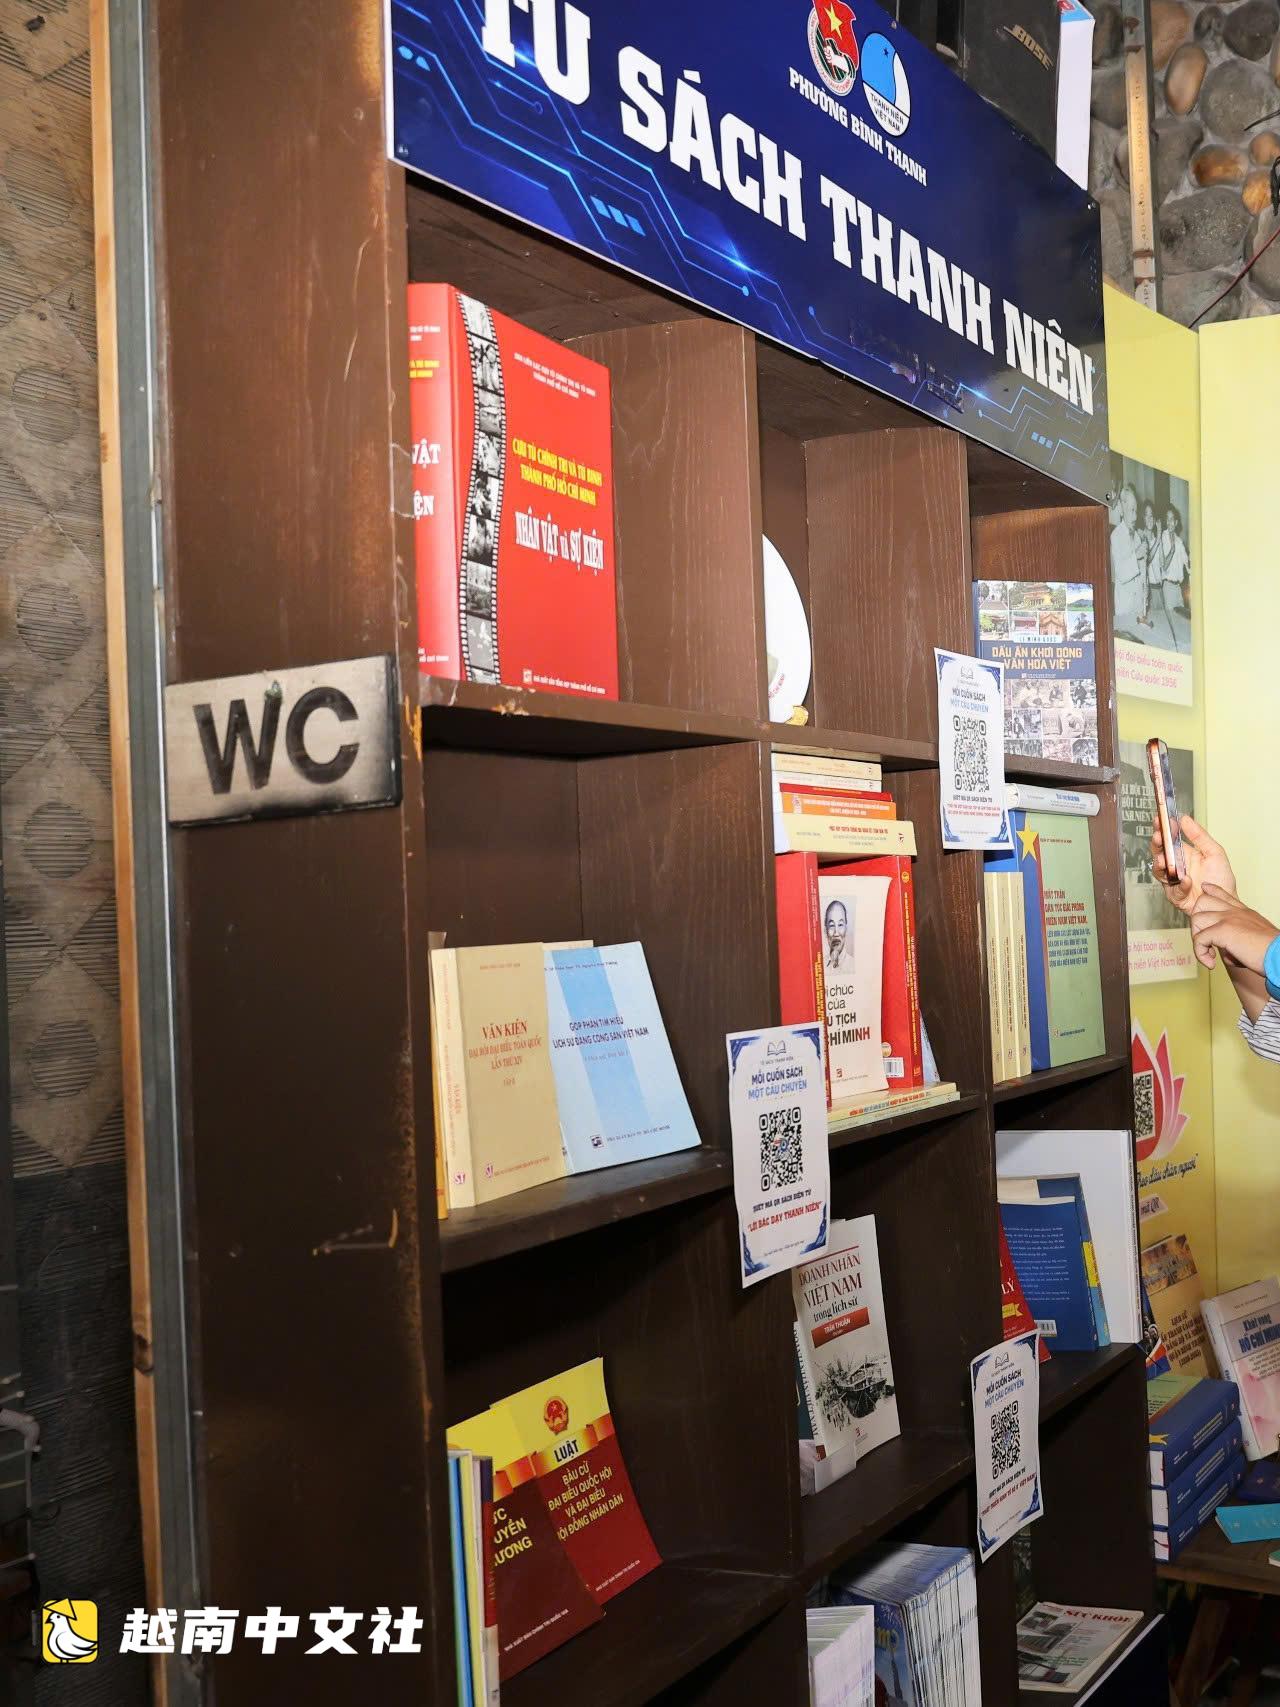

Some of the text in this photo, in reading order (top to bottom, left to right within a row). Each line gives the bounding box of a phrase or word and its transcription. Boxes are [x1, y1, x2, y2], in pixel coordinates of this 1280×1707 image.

[1003, 24, 1053, 70] BOSE
[789, 67, 927, 187] PHƯỜNG BÌNH THẠNH
[618, 46, 806, 241] SÁCH
[820, 176, 995, 354] THANH
[1004, 299, 1095, 414] NIÊN
[515, 506, 540, 551] NHÂN
[540, 512, 559, 563] VẬT
[570, 528, 582, 571] SỰ
[583, 529, 604, 576] KIỆN
[1050, 658, 1072, 672] VIỆT
[192, 687, 360, 795] WC
[829, 984, 854, 997] chúc
[827, 998, 846, 1011] của
[482, 1022, 503, 1040] VĂN
[635, 1026, 650, 1038] NAM
[835, 1012, 857, 1028] TỊCH
[842, 1026, 870, 1044] MINH
[751, 1065, 803, 1085] MỖI CUỐN SÁCH
[765, 1082, 780, 1096] CÂU
[781, 1078, 807, 1093] CHUYỆN
[784, 1206, 804, 1220] THANH
[798, 1253, 861, 1286] DOANH NHÂN
[803, 1272, 863, 1308] VIỆT NAM
[1001, 1277, 1015, 1295] LÝ
[813, 1296, 859, 1322] trong lịch sử
[554, 1439, 579, 1462] LUẬT
[562, 1460, 590, 1486] BẦU CỬ
[548, 1466, 613, 1511] ĐẠI BIỂU QUỐC HỘI
[565, 1486, 606, 1517] VÀ ĐẠI BIỂU
[568, 1516, 590, 1535] ĐỒNG
[589, 1502, 610, 1521] NHÂN
[608, 1493, 624, 1509] DÂN
[494, 1517, 527, 1544] UYỀN
[494, 1536, 533, 1567] ƯƠNG
